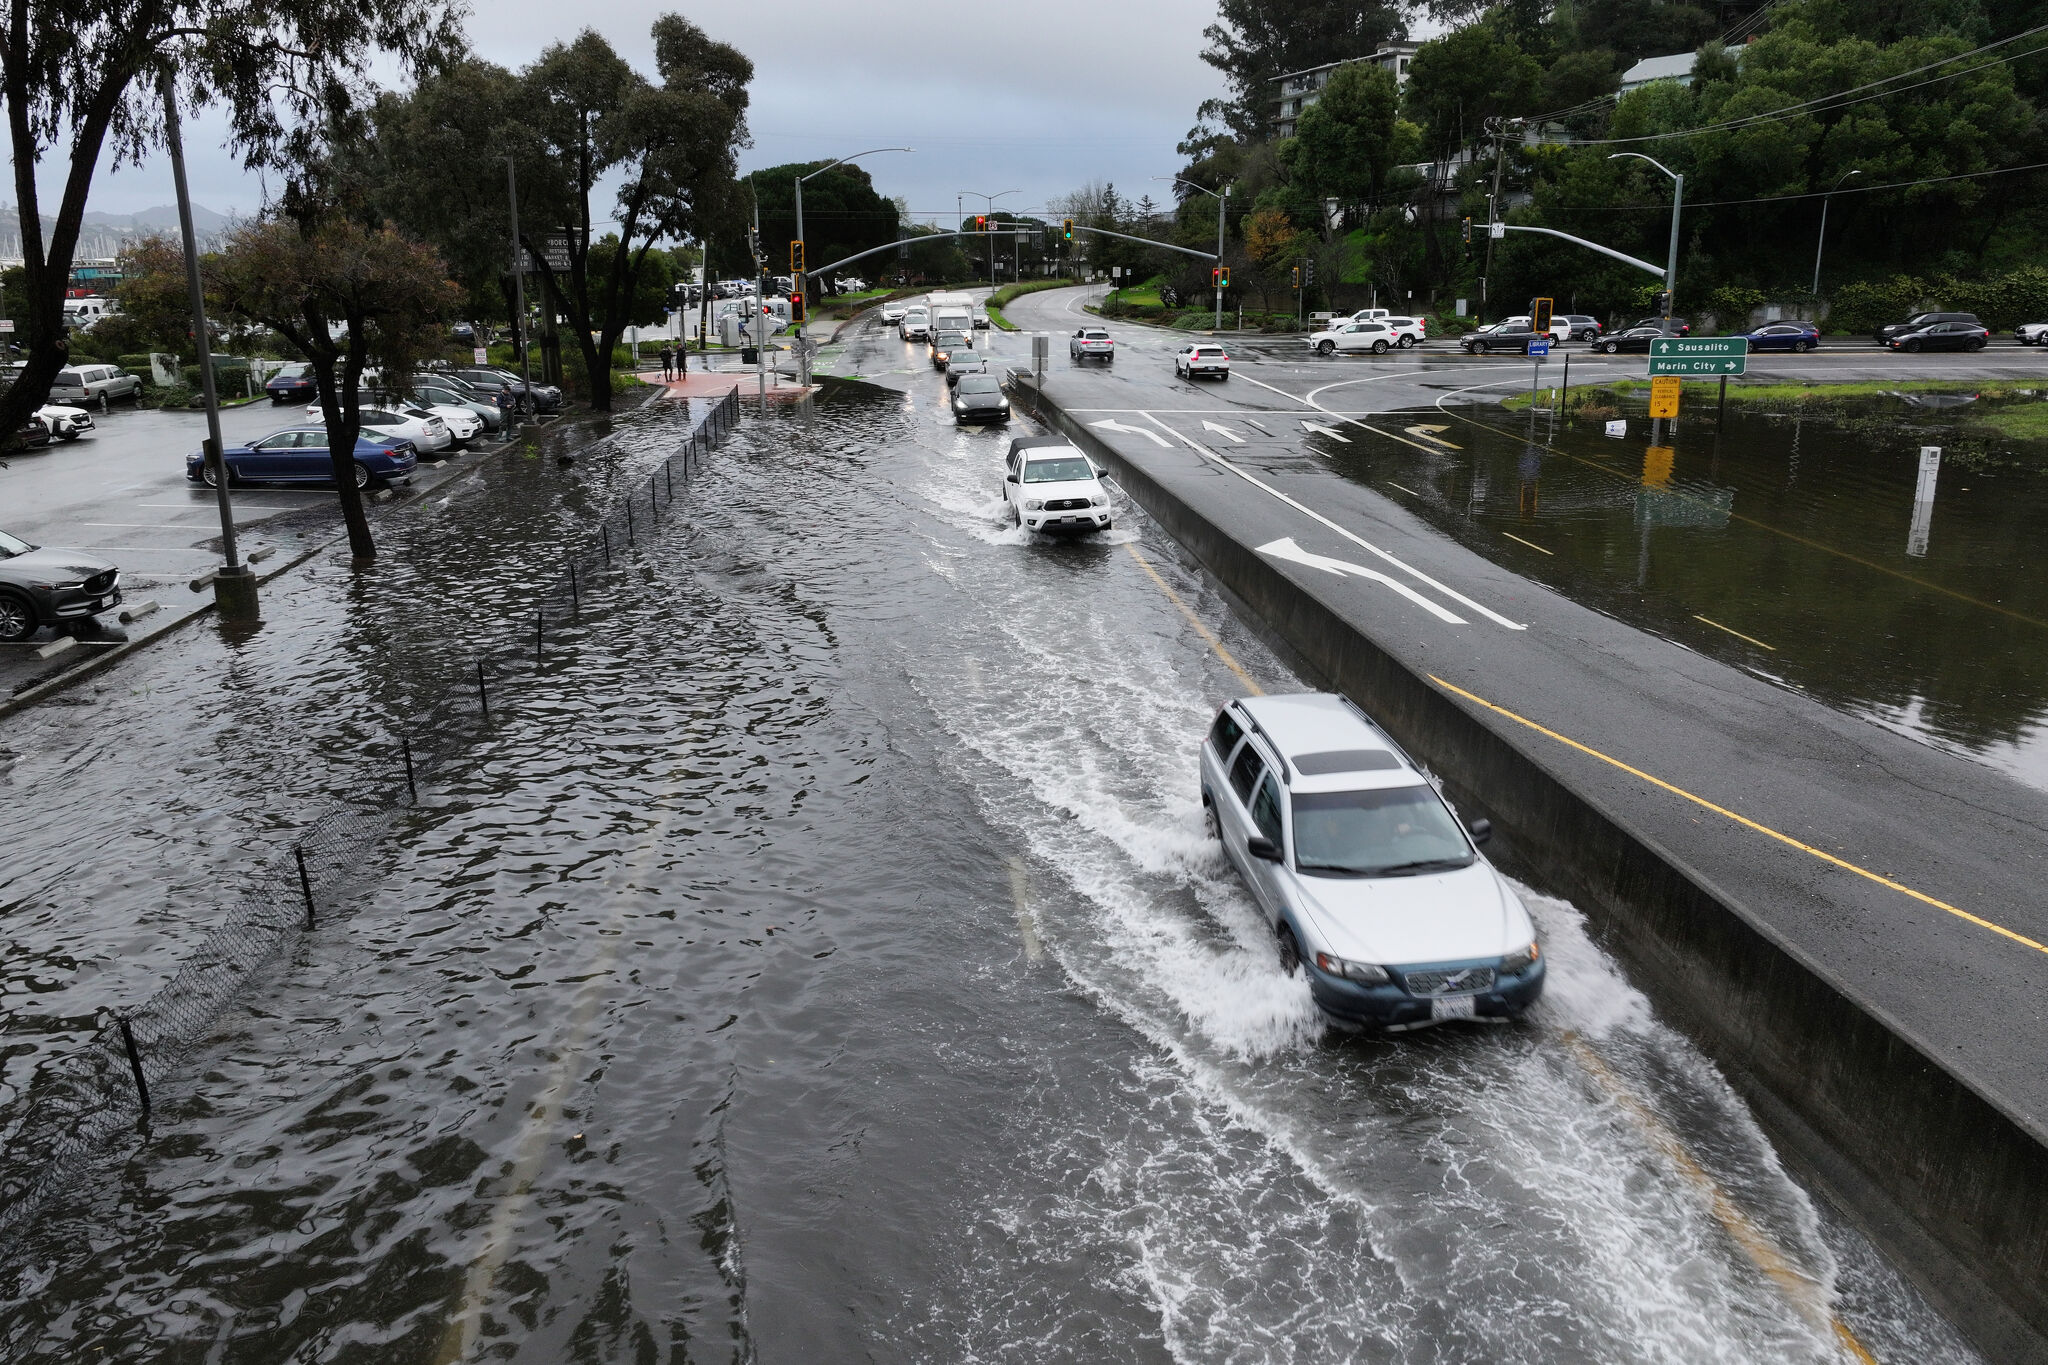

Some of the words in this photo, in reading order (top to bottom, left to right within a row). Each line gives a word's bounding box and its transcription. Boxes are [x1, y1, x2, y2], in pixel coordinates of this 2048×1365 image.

[1678, 343, 1729, 351] Sausalito
[1657, 362, 1687, 370] Marin
[1693, 362, 1716, 372] City
